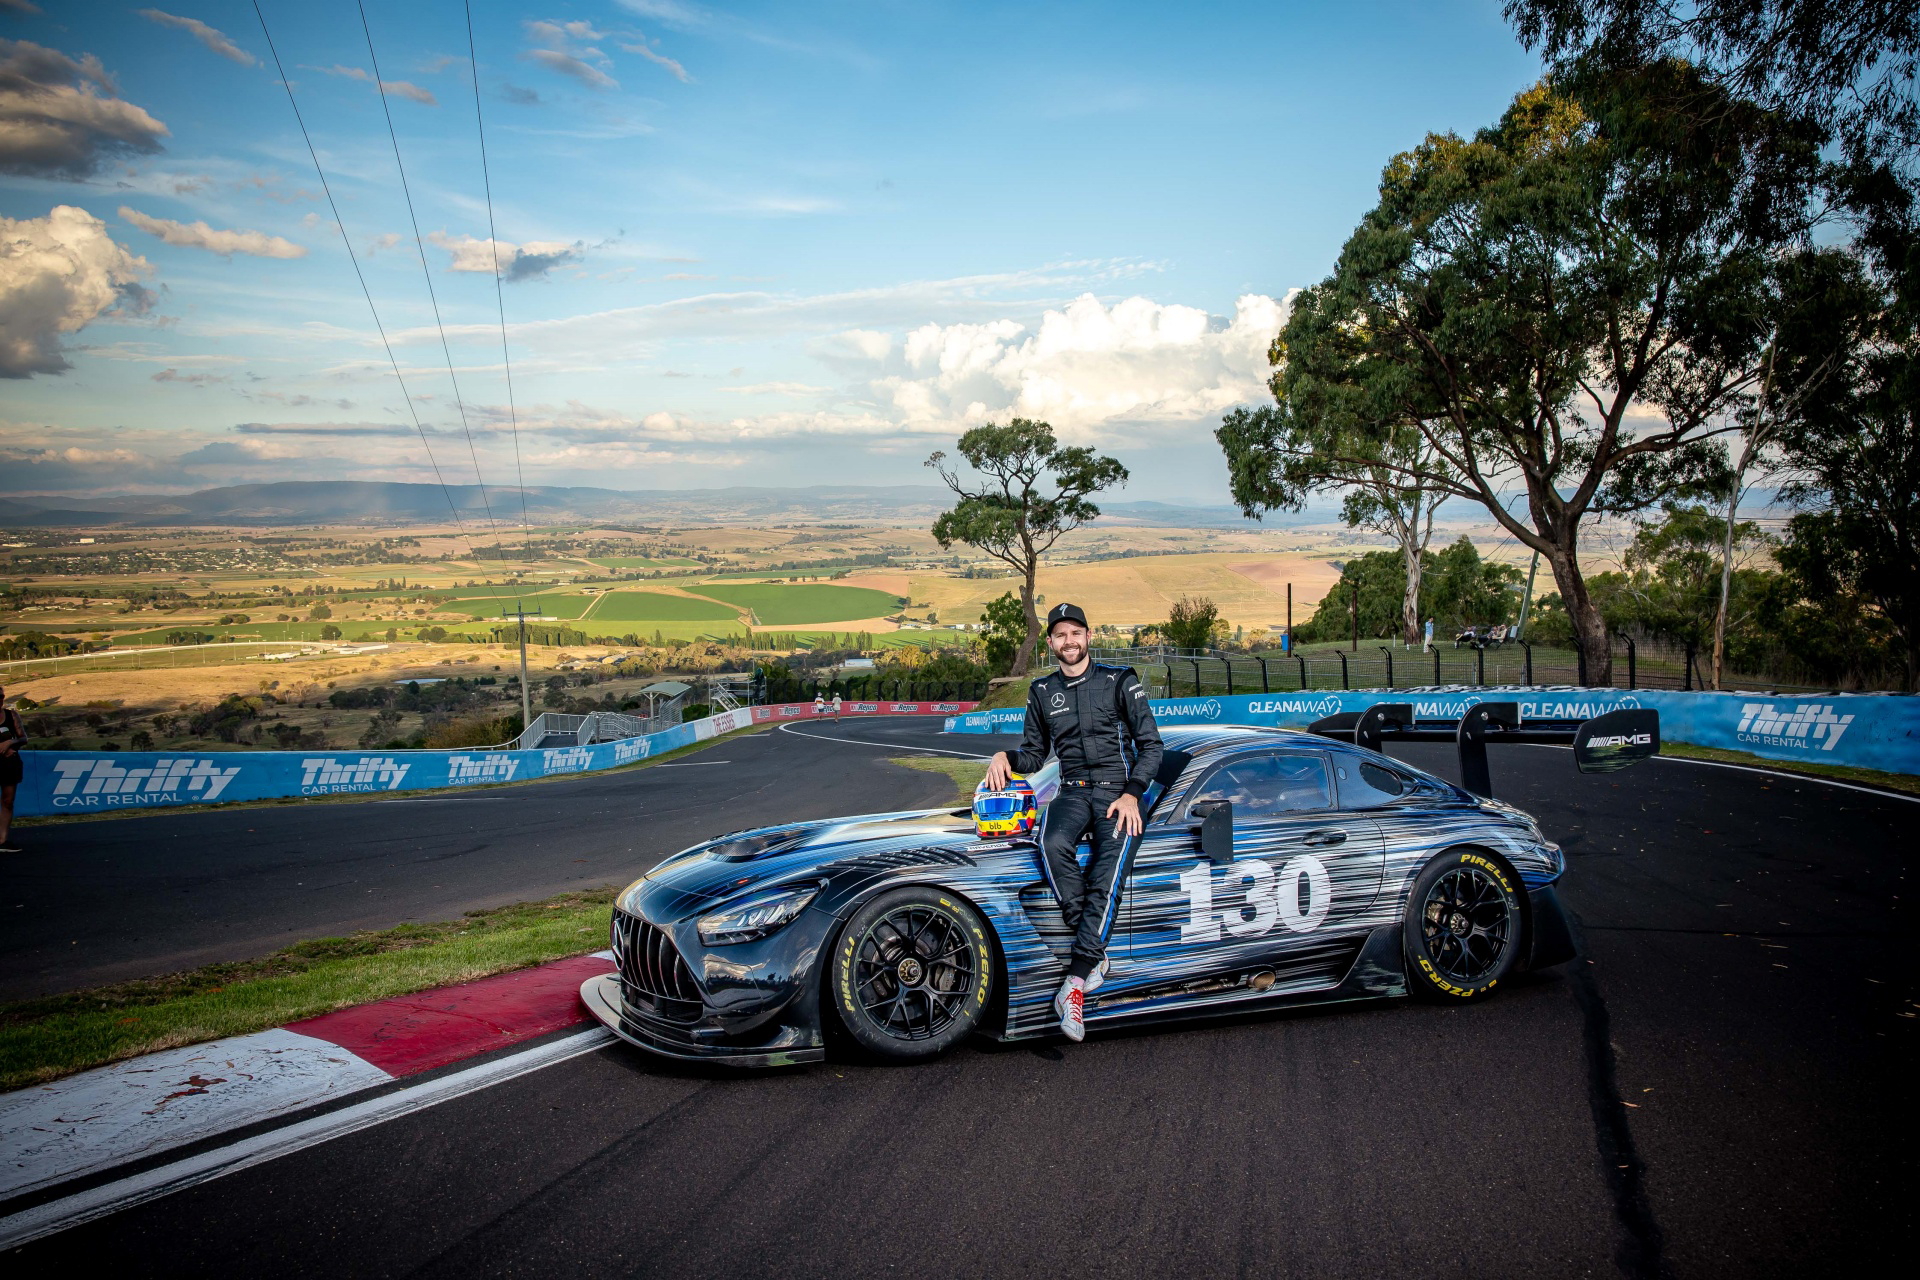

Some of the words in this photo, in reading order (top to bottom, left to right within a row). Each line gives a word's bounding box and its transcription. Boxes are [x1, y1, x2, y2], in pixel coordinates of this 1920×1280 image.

[1249, 701, 1336, 714] CLEANAWAY
[1737, 703, 1855, 751] Thrifty
[615, 739, 652, 758] Thrifty
[1606, 733, 1651, 747] AMG
[1737, 733, 1760, 743] CAR
[1764, 736, 1809, 749] RENTAL
[448, 755, 520, 780] Thrifty
[543, 748, 595, 770] Thrifty
[53, 759, 242, 800] Thrifty
[301, 757, 412, 790] Thrifty
[468, 776, 497, 784] RENTAL
[53, 796, 98, 807] CAR
[107, 793, 183, 805] RENTAL
[302, 785, 328, 795] CAR
[332, 783, 376, 793] RENTAL
[1461, 854, 1514, 893] PIRELLI
[1180, 855, 1331, 944] 130
[841, 936, 856, 1013] PIRELLI
